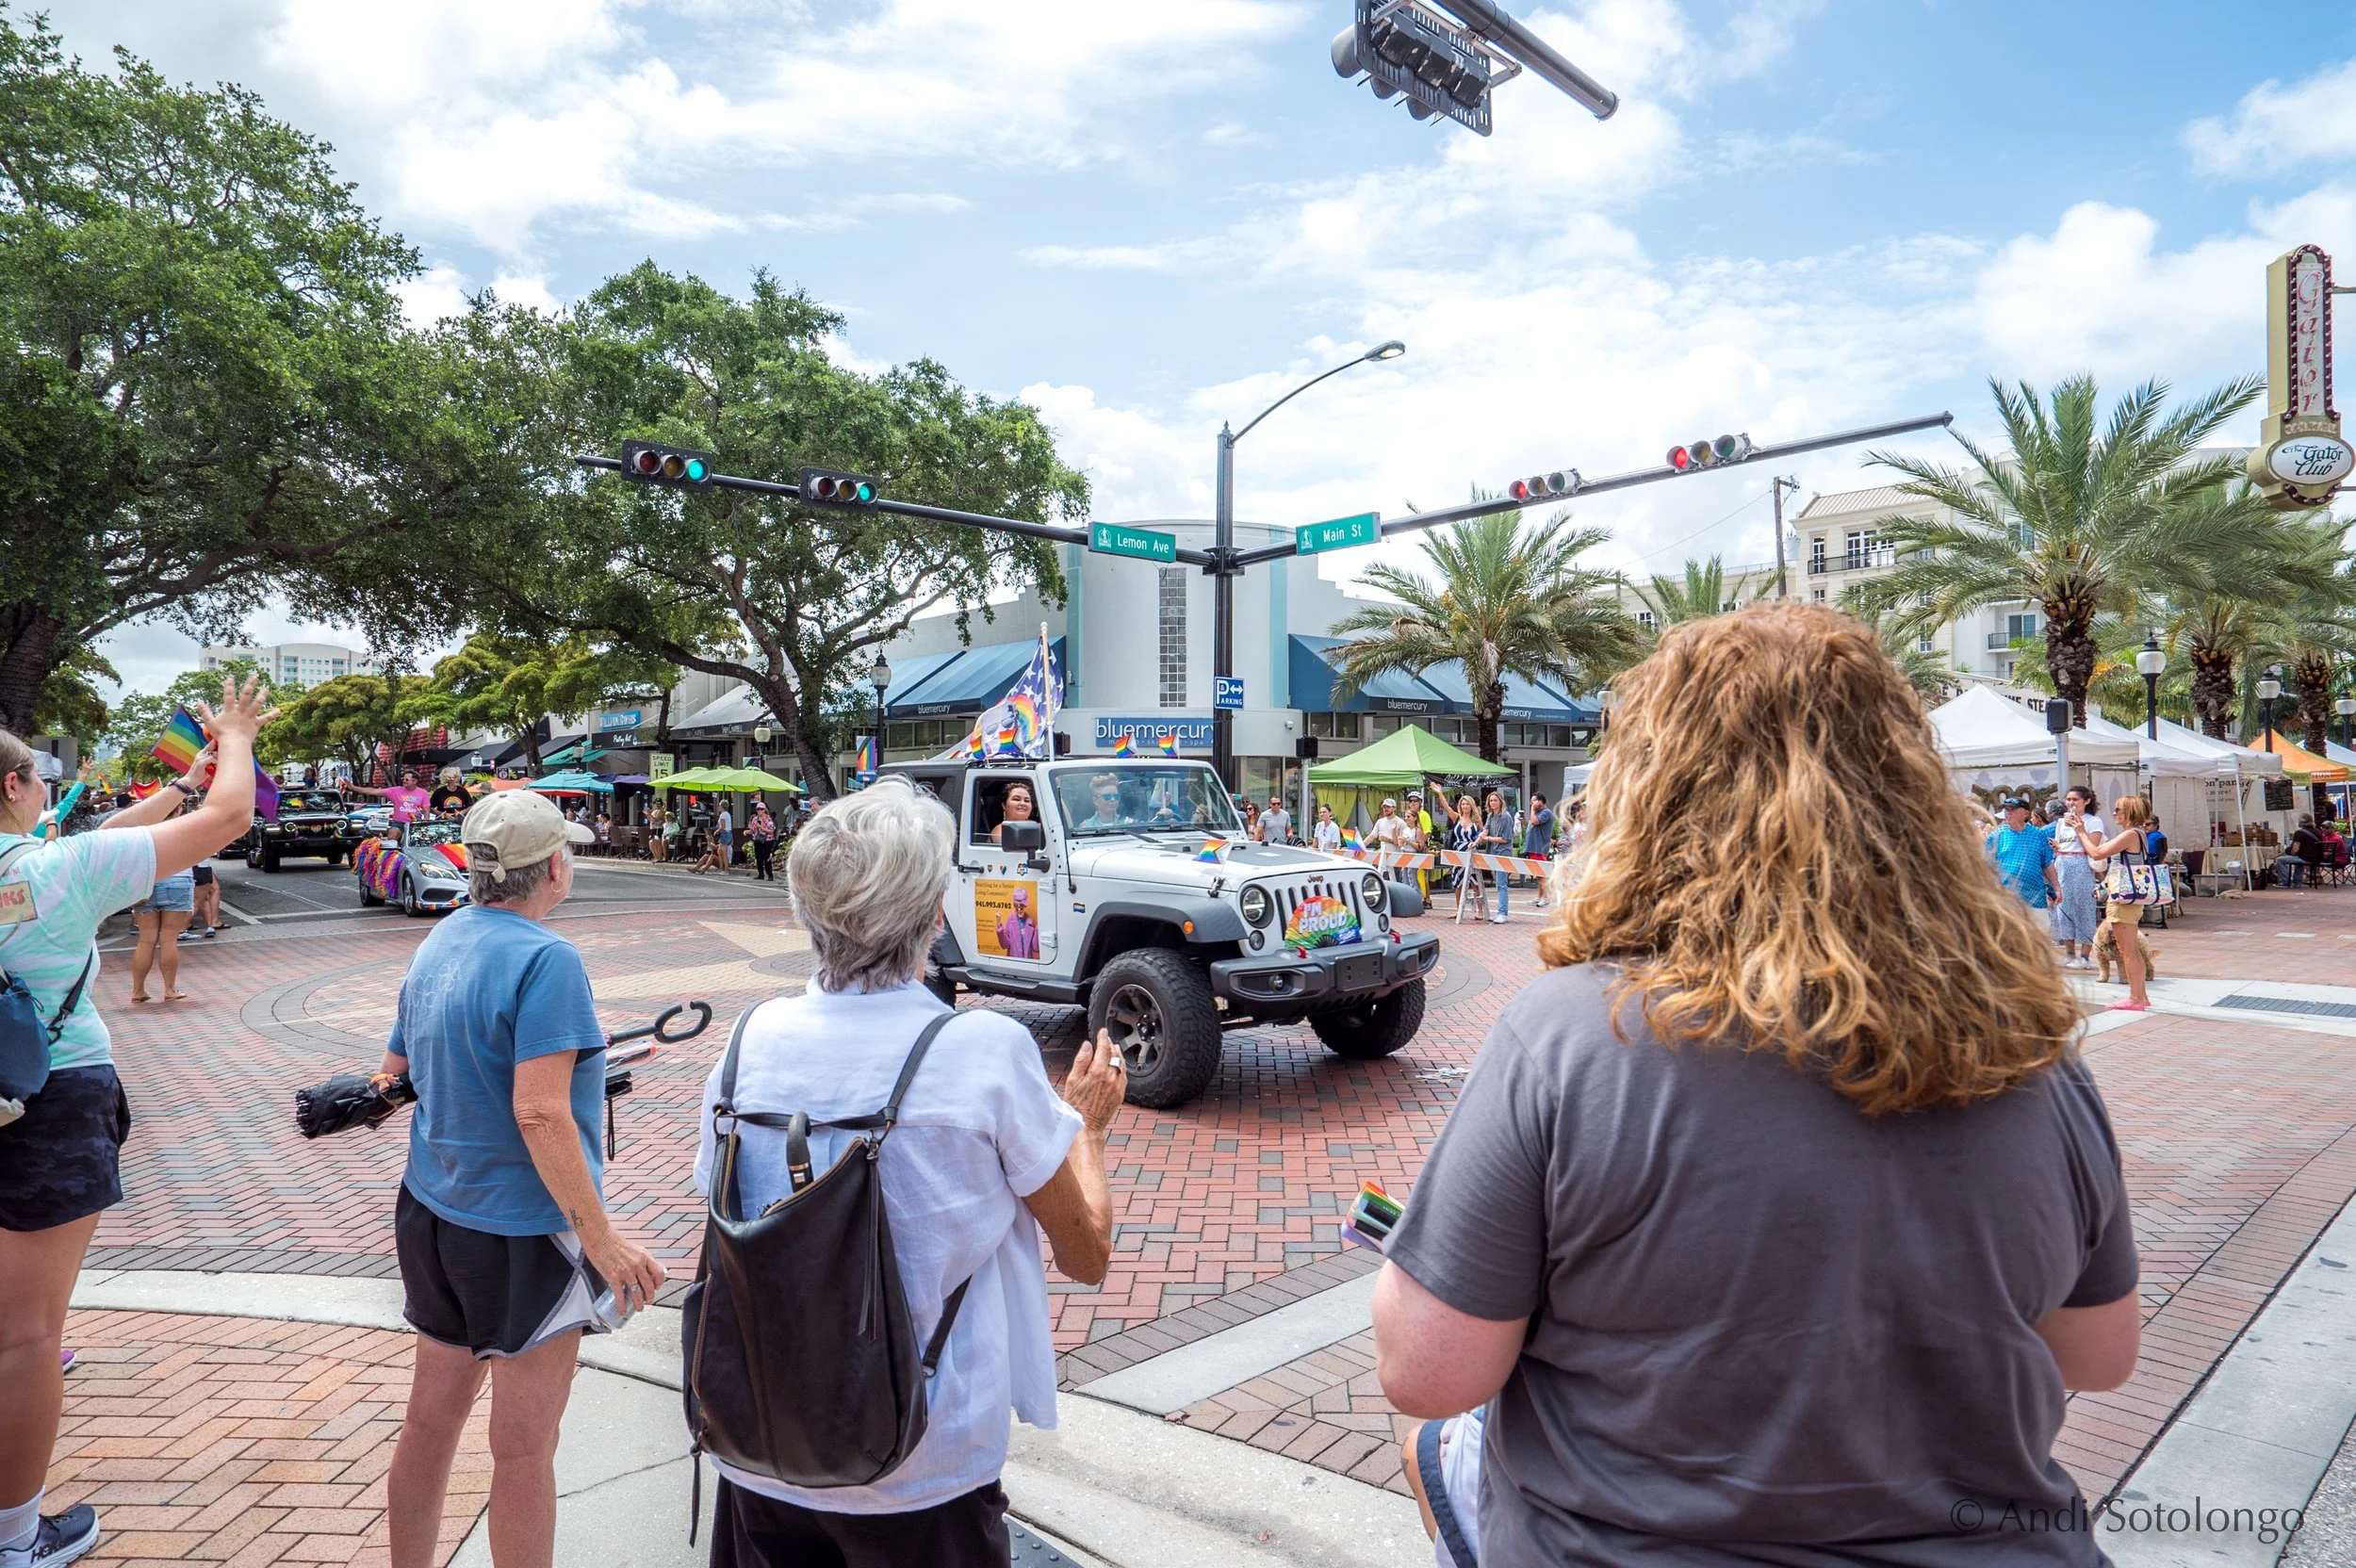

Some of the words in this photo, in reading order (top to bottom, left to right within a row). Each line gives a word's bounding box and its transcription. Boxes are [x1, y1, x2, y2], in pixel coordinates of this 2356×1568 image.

[2303, 445, 2344, 463] Gator
[2295, 460, 2336, 476] Club
[1322, 528, 1345, 543] Main
[1351, 523, 1362, 538] St
[1117, 533, 1147, 550] Lemon
[1153, 539, 1169, 553] Ave
[918, 704, 951, 714] bluemercury
[1387, 698, 1428, 712] bluemercury
[1500, 709, 1532, 720] uemercury
[1096, 718, 1214, 743] bluemercur
[655, 769, 668, 778] 15
[1307, 874, 1324, 883] Jeep
[1299, 910, 1348, 934] PROUD
